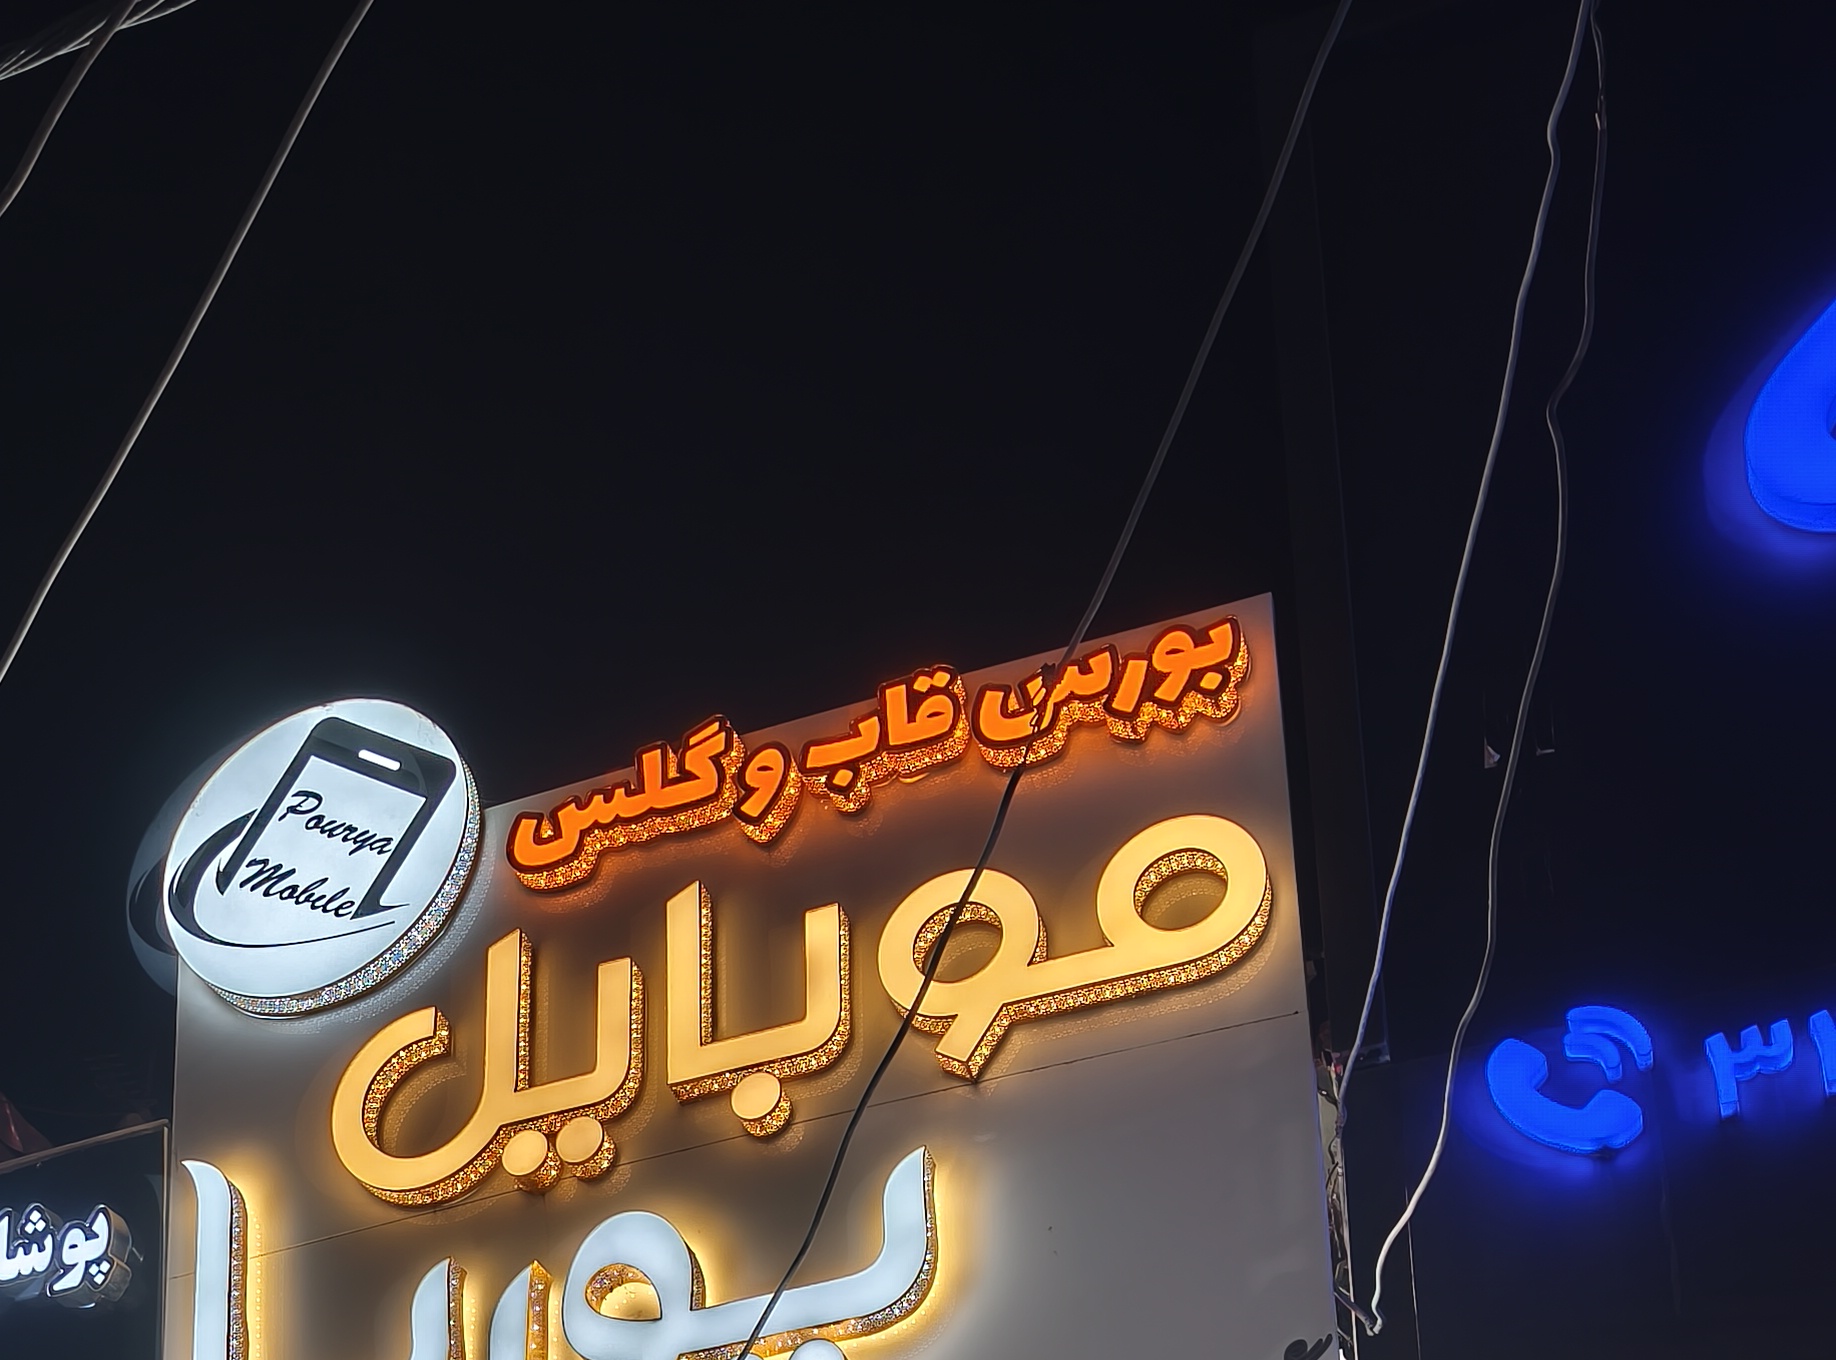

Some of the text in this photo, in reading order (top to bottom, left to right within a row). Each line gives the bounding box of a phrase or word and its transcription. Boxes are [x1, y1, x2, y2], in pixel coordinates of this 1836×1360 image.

[281, 789, 392, 856] Pourya
[510, 615, 1248, 882] بورس قاب و گلس
[239, 857, 357, 919] Mobile
[331, 814, 1270, 1205] موبایل
